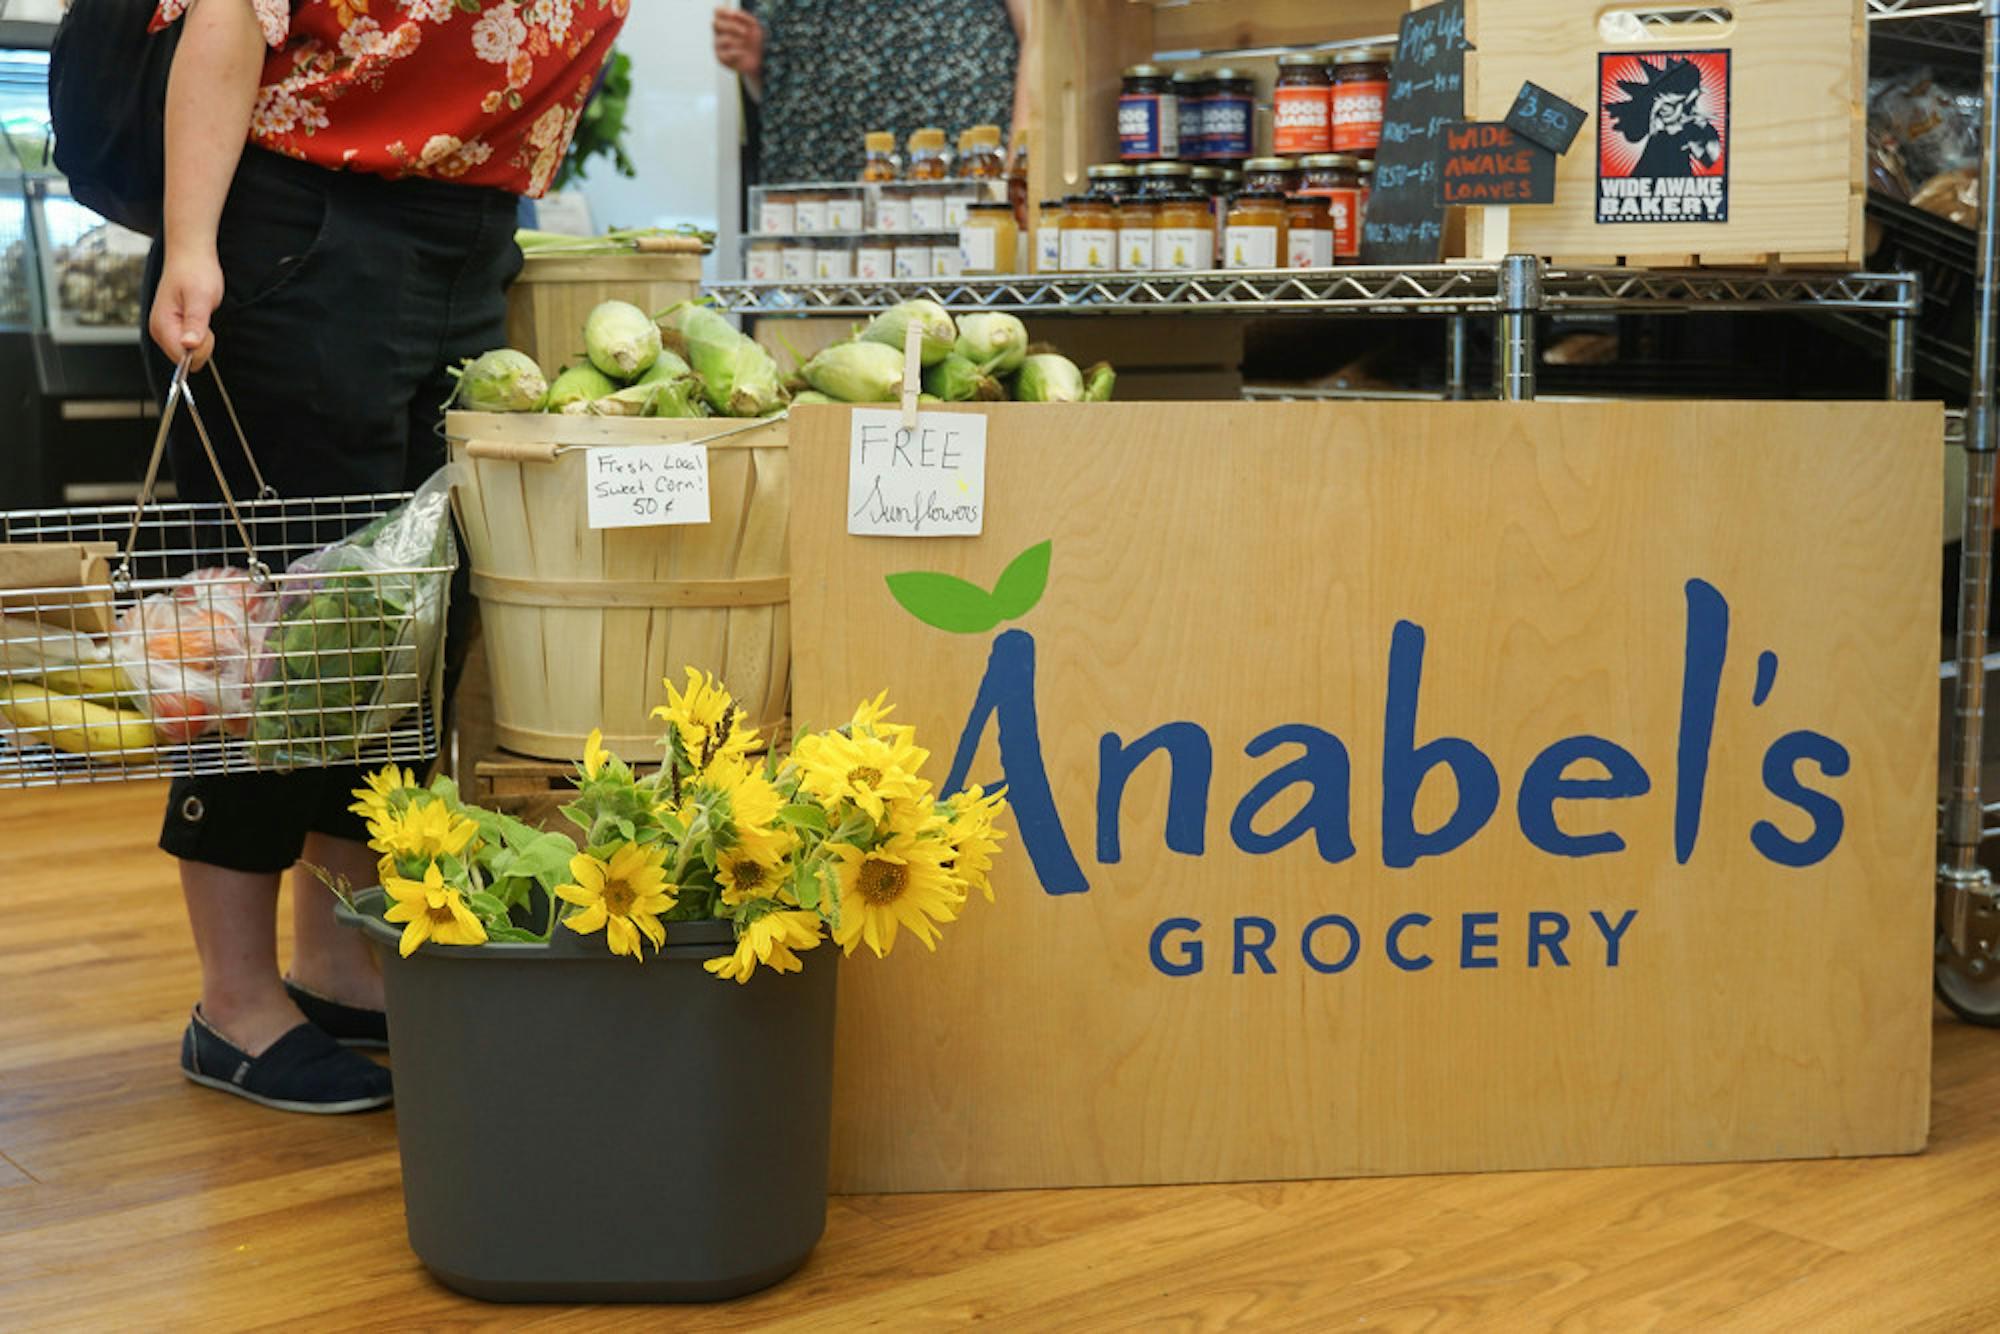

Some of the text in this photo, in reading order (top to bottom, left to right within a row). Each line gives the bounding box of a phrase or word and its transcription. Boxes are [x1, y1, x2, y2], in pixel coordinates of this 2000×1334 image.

[1447, 127, 1515, 151] WIDE
[1444, 150, 1536, 177] AWAKE
[1444, 179, 1533, 202] LOAVES
[1601, 177, 1723, 198] WIDE AWAKE
[1600, 197, 1724, 215] BAKERY
[861, 424, 963, 470] FREE
[597, 453, 704, 475] Fresh Local
[594, 478, 645, 499] Sweet
[854, 474, 978, 532] Sunflowers
[940, 578, 1849, 895] Anabel's
[1149, 910, 1639, 977] GROCERY
